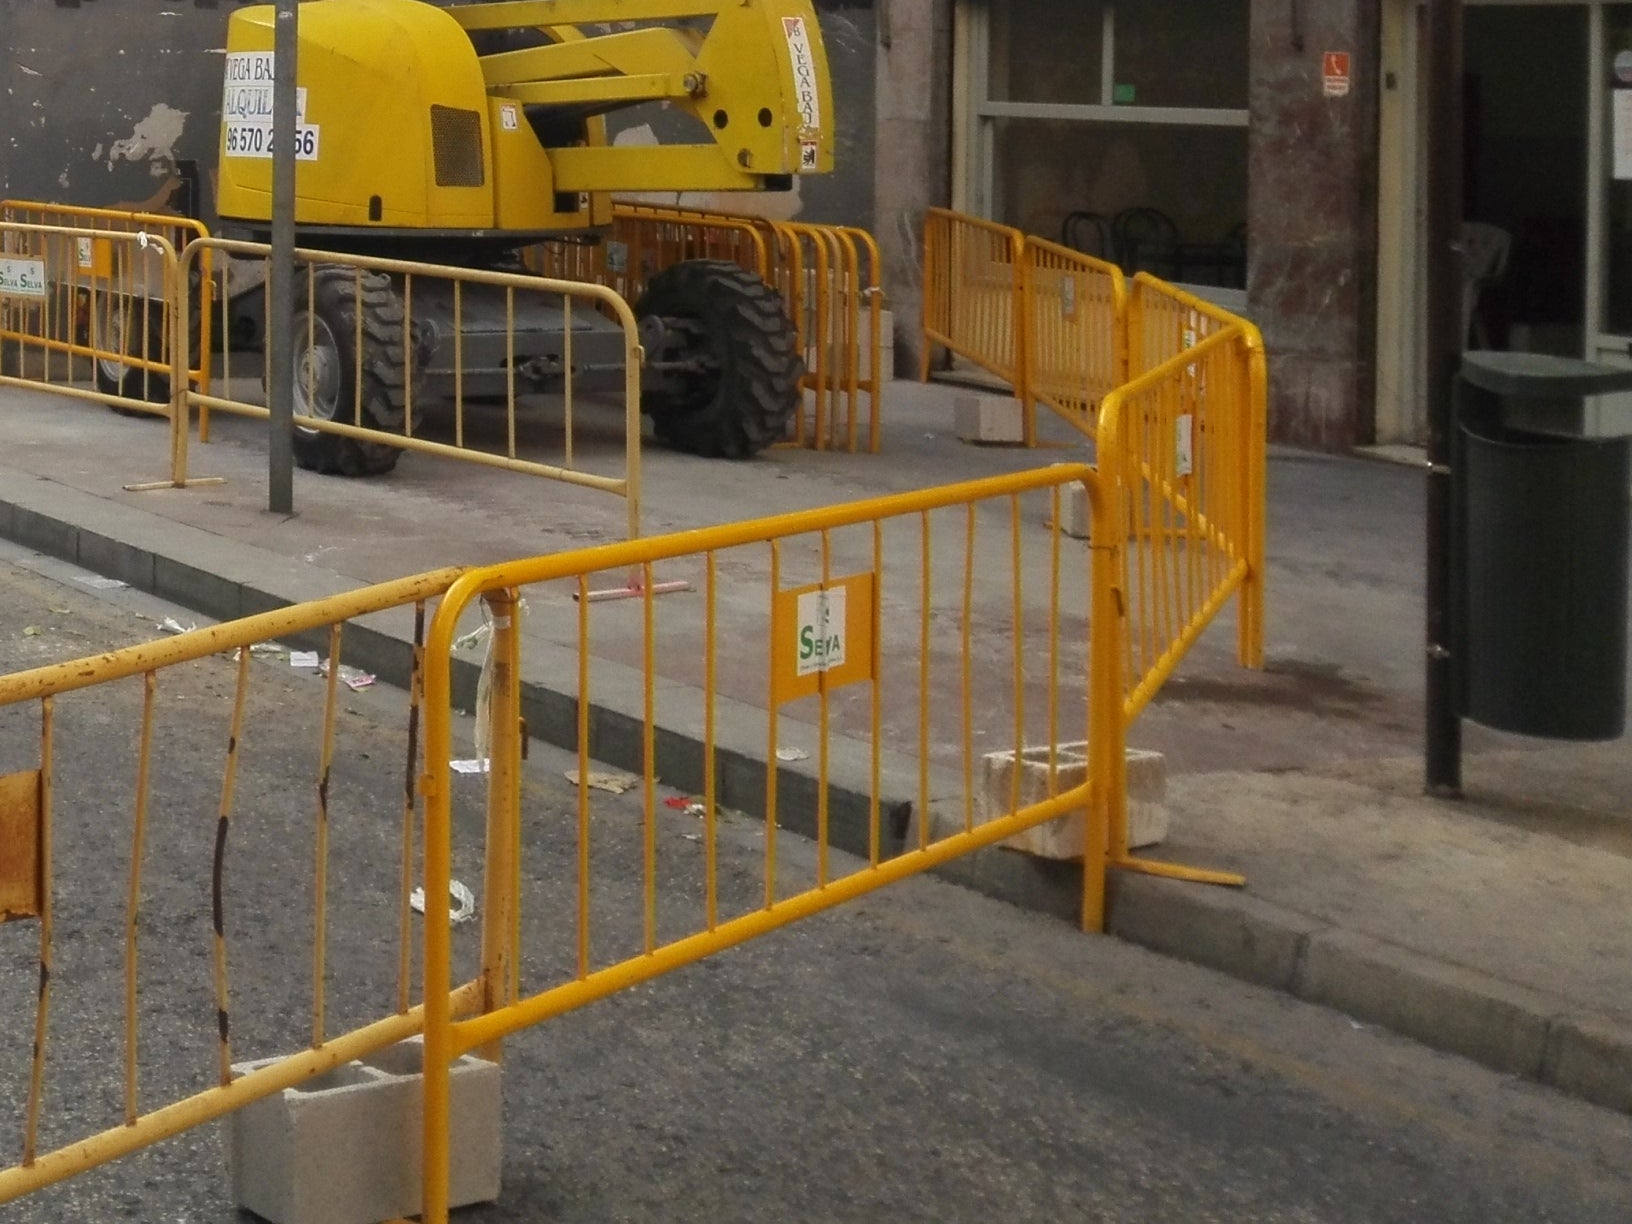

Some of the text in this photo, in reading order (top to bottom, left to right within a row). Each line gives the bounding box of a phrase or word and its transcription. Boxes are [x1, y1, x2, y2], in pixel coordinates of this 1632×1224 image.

[793, 43, 813, 125] VEGA BAJ
[228, 127, 238, 151] 96
[240, 127, 263, 152] 570
